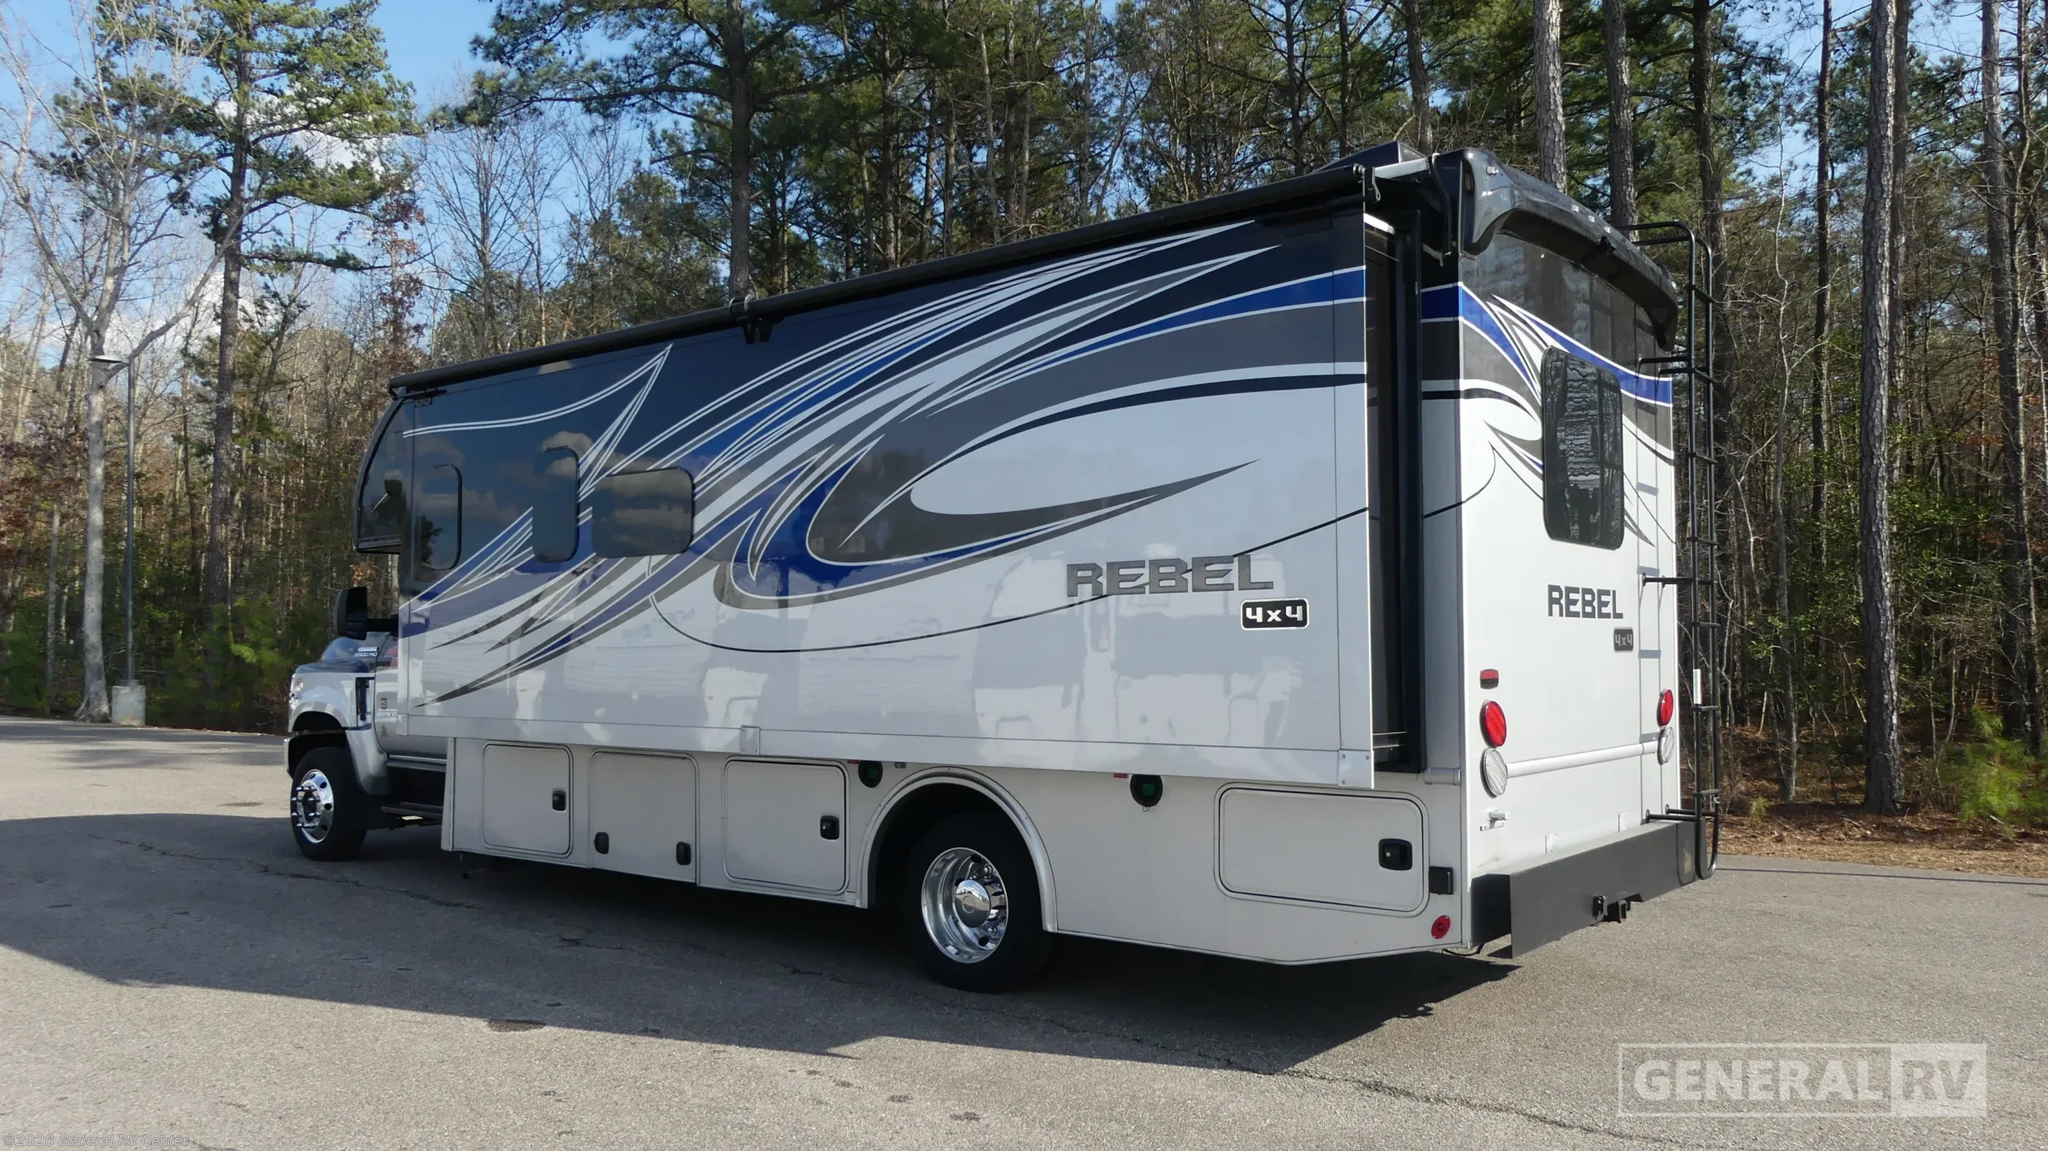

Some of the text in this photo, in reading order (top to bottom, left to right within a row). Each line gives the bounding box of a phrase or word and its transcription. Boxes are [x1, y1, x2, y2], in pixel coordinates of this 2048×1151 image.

[1067, 555, 1274, 597] REBEL
[1245, 605, 1303, 623] 4x4
[1547, 584, 1623, 619] REBEL
[1614, 633, 1633, 646] 4x4
